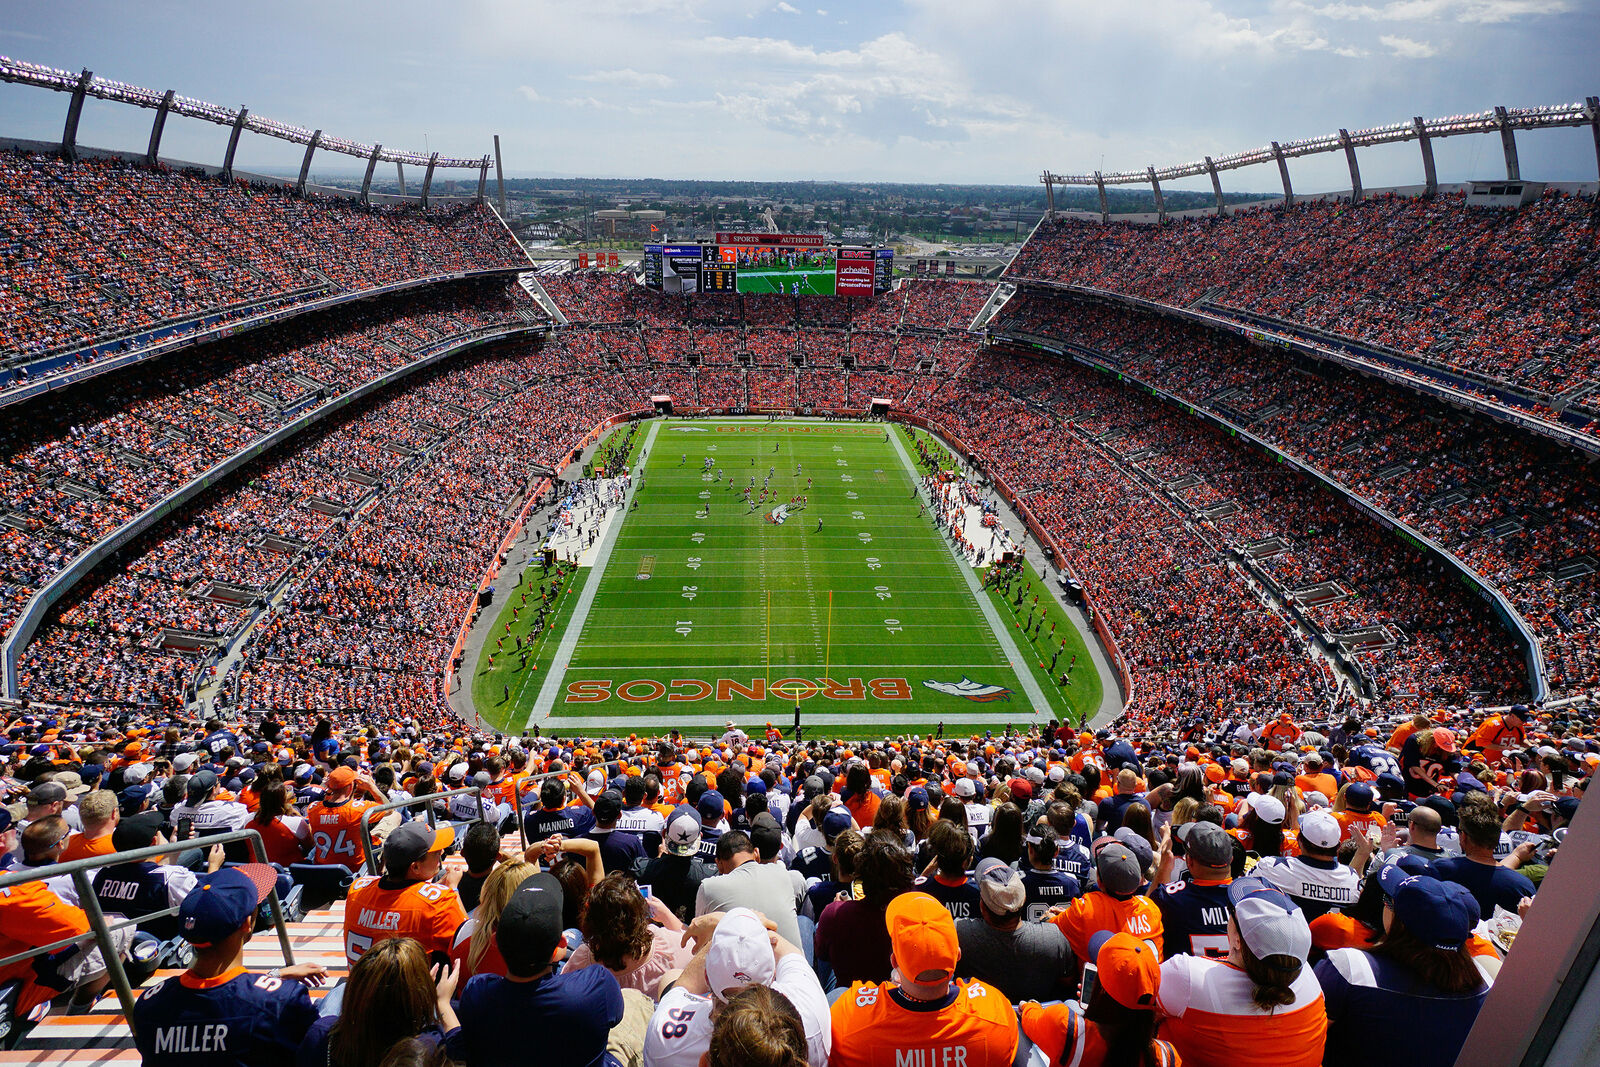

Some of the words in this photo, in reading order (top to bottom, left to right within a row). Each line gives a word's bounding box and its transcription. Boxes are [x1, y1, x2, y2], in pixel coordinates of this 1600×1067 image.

[781, 236, 823, 244] AUTHORITY
[841, 266, 870, 275] uchealth
[1460, 398, 1475, 407] SMITH
[716, 425, 884, 434] BRONCOS
[1522, 420, 1549, 434] SHANNON
[1549, 429, 1572, 442] SHARPE
[1395, 528, 1428, 553] QUARTERBACKS
[686, 557, 702, 568] 30
[865, 557, 881, 568] 30
[681, 585, 698, 598] 20
[874, 585, 892, 598] 20
[675, 620, 692, 633] 10
[884, 618, 902, 631] 10
[564, 678, 913, 703] BRONCOS
[456, 802, 477, 817] WITTEN
[319, 813, 340, 825] WARE
[539, 818, 574, 833] MANNING
[314, 829, 356, 861] 94
[99, 879, 140, 900] ROMO
[1039, 885, 1064, 896] WITTEN
[1301, 882, 1351, 902] PRESCOTT
[357, 907, 401, 931] MILLER
[856, 985, 880, 1008] 58
[662, 1008, 696, 1040] 58
[154, 1023, 229, 1055] MILLER
[895, 1045, 968, 1067] MILLER
